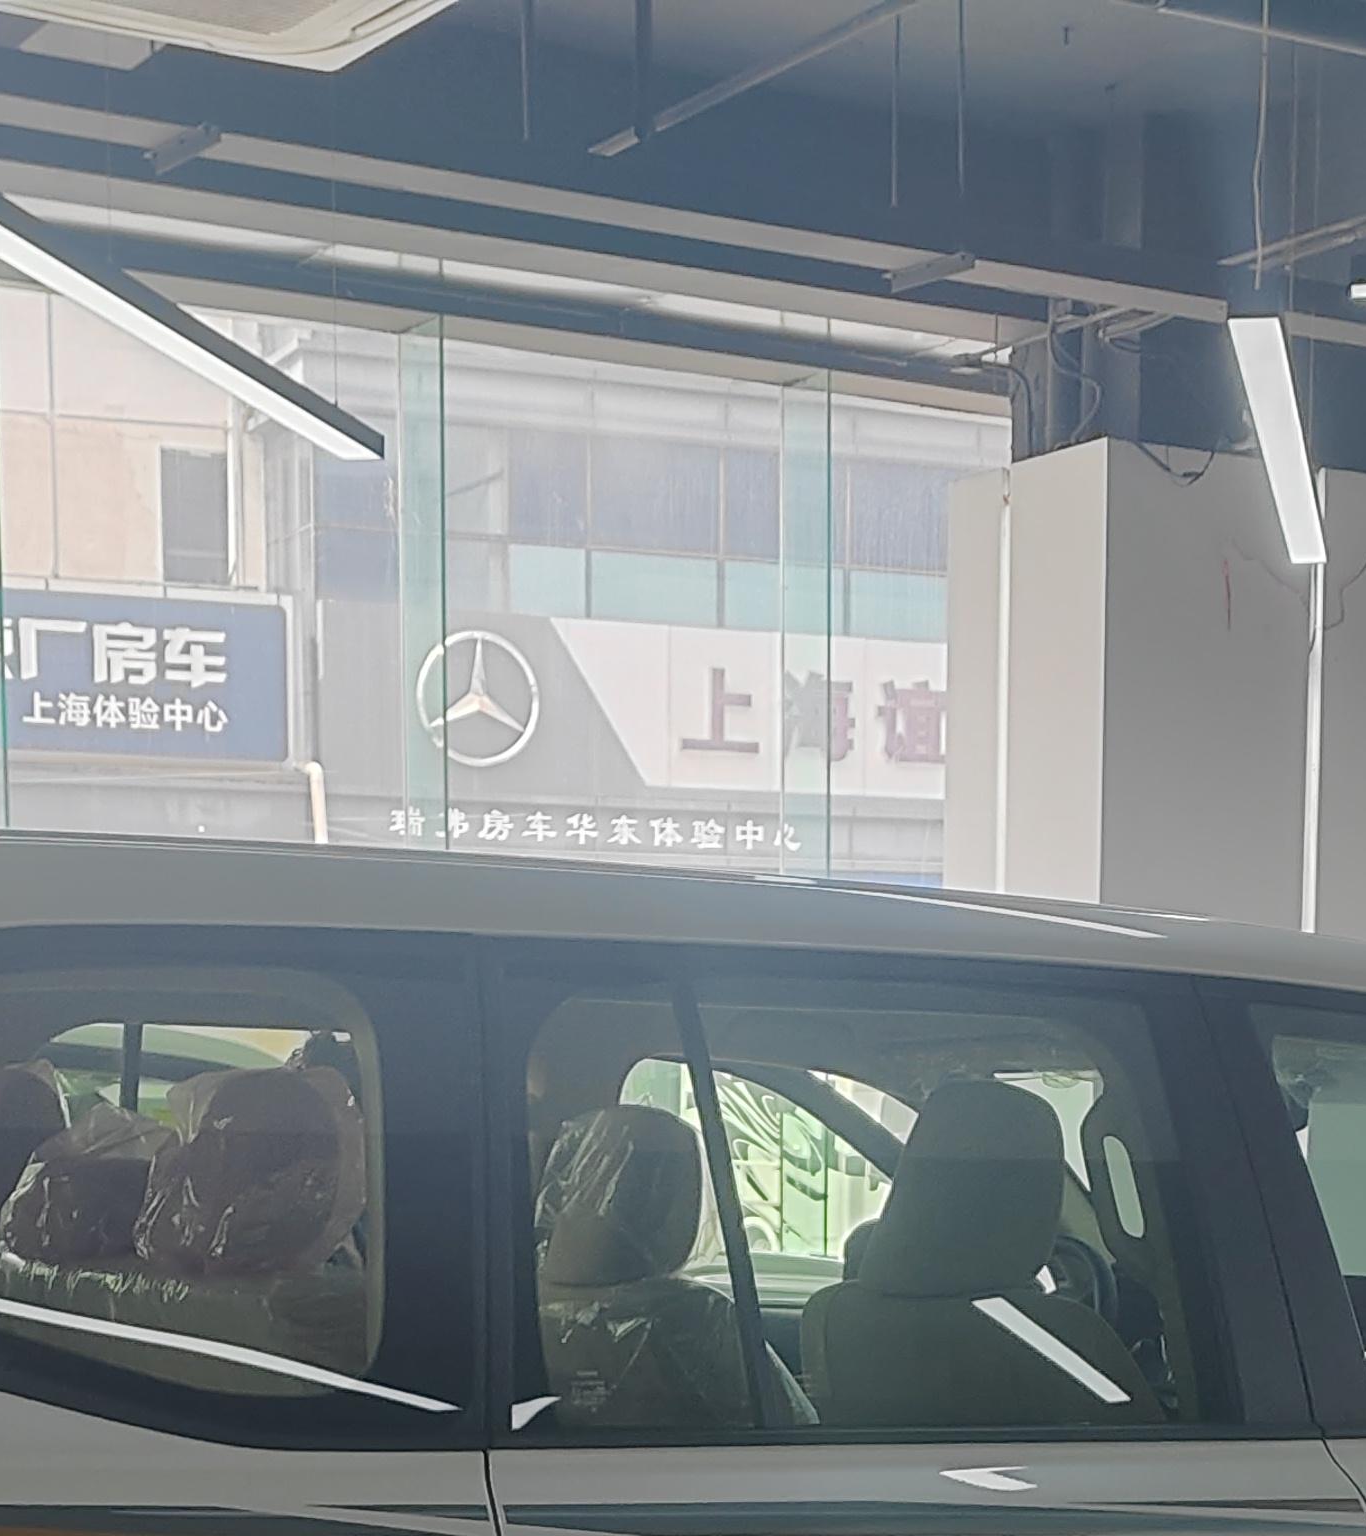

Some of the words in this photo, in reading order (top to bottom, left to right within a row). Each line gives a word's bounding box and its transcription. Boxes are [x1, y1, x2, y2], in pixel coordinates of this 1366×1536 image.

[22, 691, 228, 732] 上海体验中心
